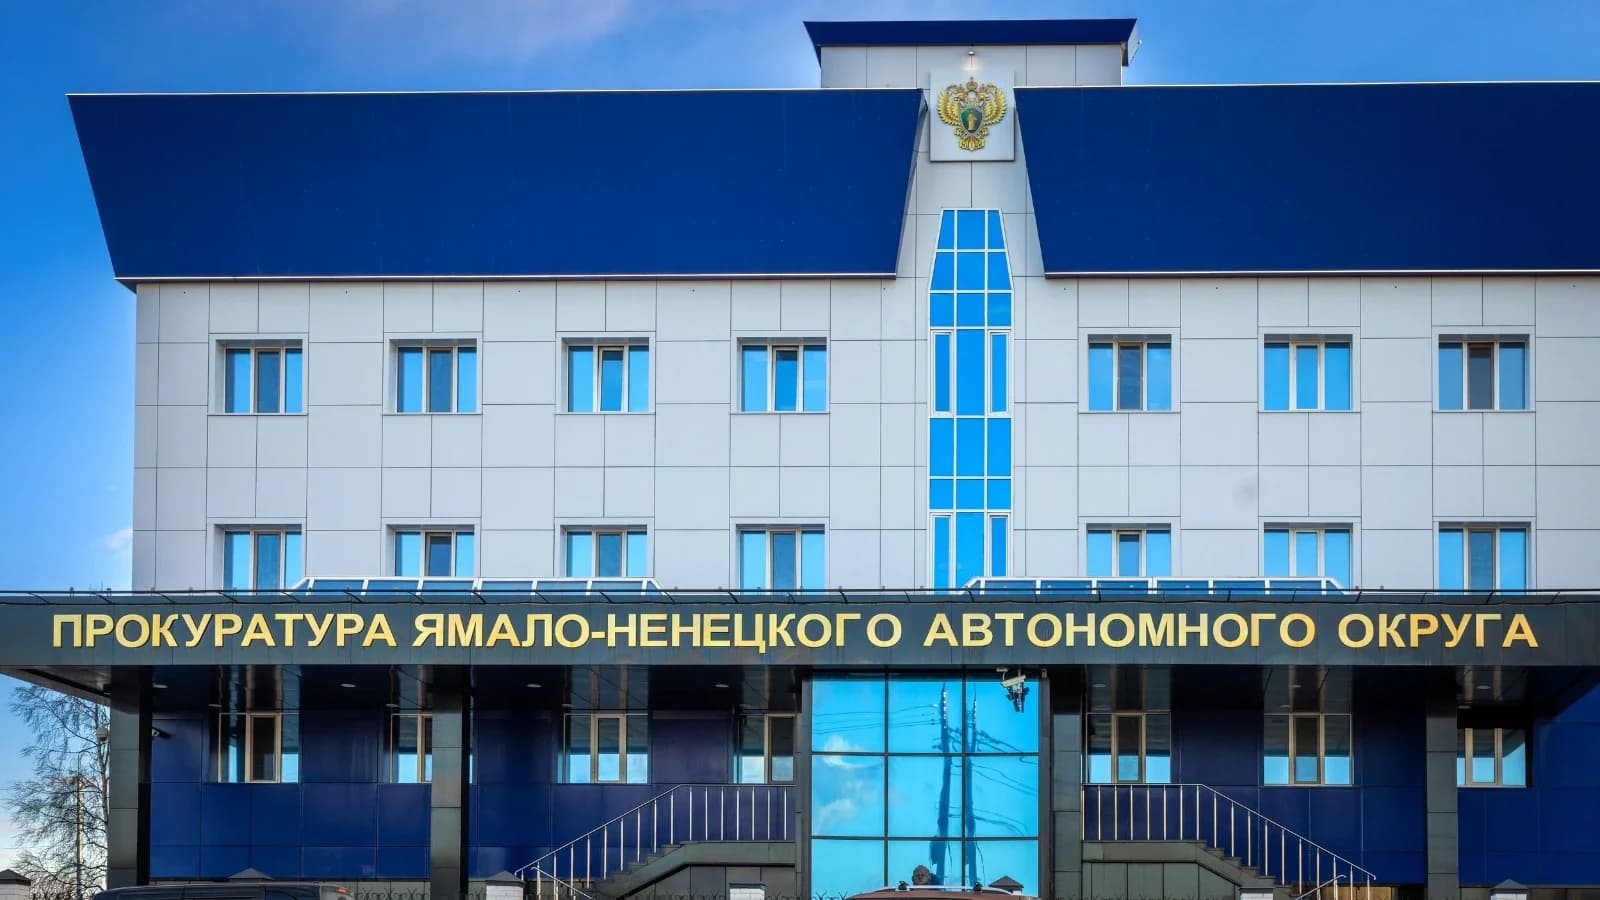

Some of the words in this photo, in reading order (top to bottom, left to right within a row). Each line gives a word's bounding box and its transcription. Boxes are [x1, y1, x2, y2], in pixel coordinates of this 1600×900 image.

[52, 613, 397, 647] ПРОКУРАТУРА
[412, 613, 902, 653] ЯМАЛО-НЕНЕЦКОГО
[923, 612, 1316, 647] АВТОНОМНОГО
[1338, 613, 1538, 647] ОКРУГА
